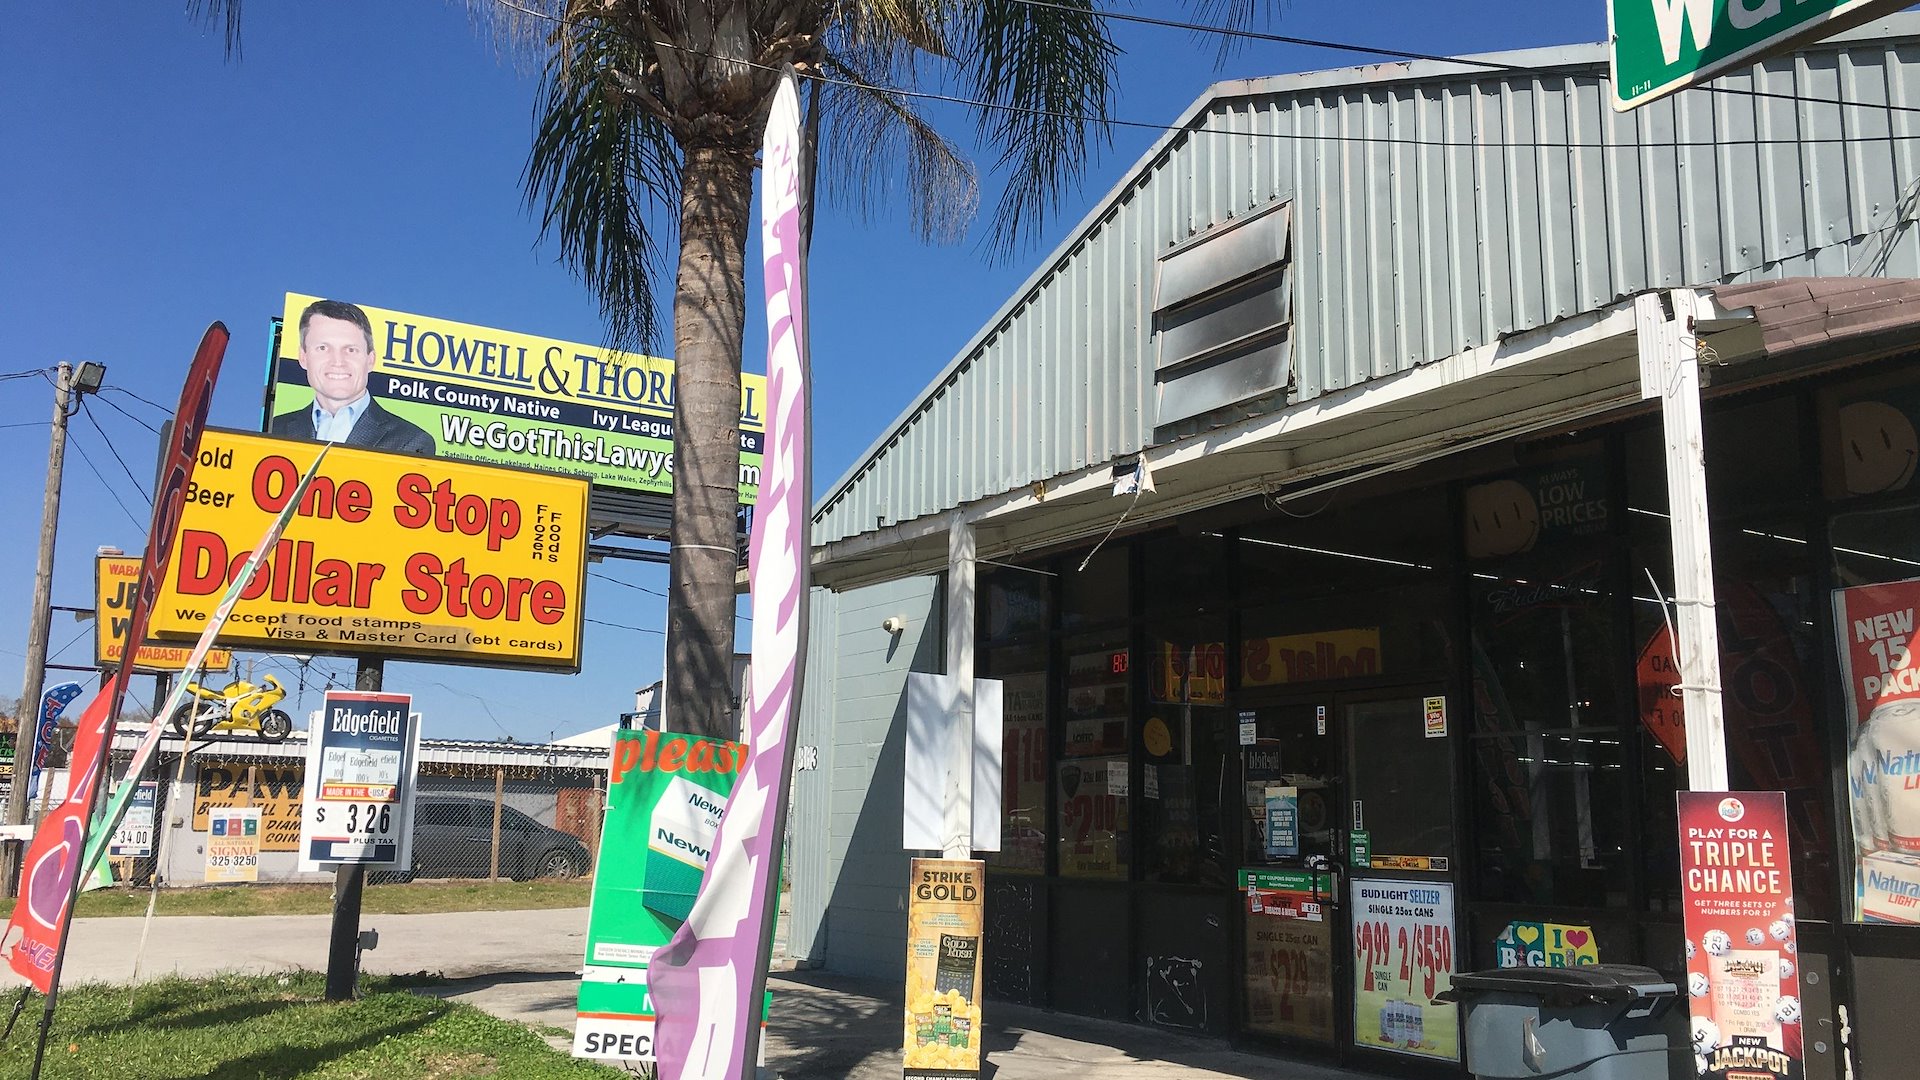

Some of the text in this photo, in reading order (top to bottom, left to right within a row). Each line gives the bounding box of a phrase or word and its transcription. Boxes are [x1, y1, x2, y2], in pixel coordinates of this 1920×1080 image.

[1631, 80, 1650, 96] 11-11
[383, 321, 759, 420] HOWELL & THORL
[388, 379, 430, 399] Polk
[434, 386, 499, 412] County
[504, 396, 560, 419] Native
[593, 410, 618, 431] Ivy
[194, 447, 233, 469] old
[475, 455, 498, 464] Offices
[601, 472, 616, 480] Lake
[185, 482, 234, 508] Beer
[252, 455, 521, 551] One Stop
[1540, 481, 1585, 507] LOW
[1542, 499, 1608, 528] PRICES
[532, 504, 548, 560] Frozen
[548, 512, 562, 562] Foods
[176, 529, 566, 625] Dollar Store
[176, 609, 421, 630] We ccept food stamps
[1855, 608, 1913, 643] NEW
[265, 627, 563, 651] Visa & Master Card (ebt cards)
[138, 646, 182, 661] WABASH
[1869, 635, 1911, 673] 15
[331, 708, 400, 736] Edgefield
[326, 788, 385, 797] MADE IN THE USA
[316, 804, 391, 834] $ 3.26
[704, 818, 719, 829] BOX
[120, 831, 148, 844] 34.00
[657, 827, 710, 862] New
[1689, 828, 1773, 840] PLAY FOR A
[210, 846, 256, 856] SIGNAL
[1690, 841, 1775, 867] TRIPLE
[923, 871, 972, 883] STRIKE
[1688, 868, 1782, 894] CHANCE
[1868, 869, 1920, 897] Natura
[917, 884, 977, 901] GOLD
[1361, 889, 1441, 905] BUD LIGHT SELTZER
[1888, 892, 1919, 908] LIGHT
[1368, 905, 1434, 917] SINGLE 25oz CANS
[942, 936, 967, 949] GOLD
[1256, 931, 1284, 942] SINGLE
[1302, 934, 1319, 945] CAN
[1712, 935, 1722, 951] 25
[947, 948, 973, 959] RUSH
[1375, 970, 1392, 981] SINGLE
[1378, 981, 1388, 991] CAN
[584, 1032, 656, 1057] SPEC
[1739, 1038, 1762, 1046] NEW
[1709, 1046, 1791, 1076] JACKPOT
